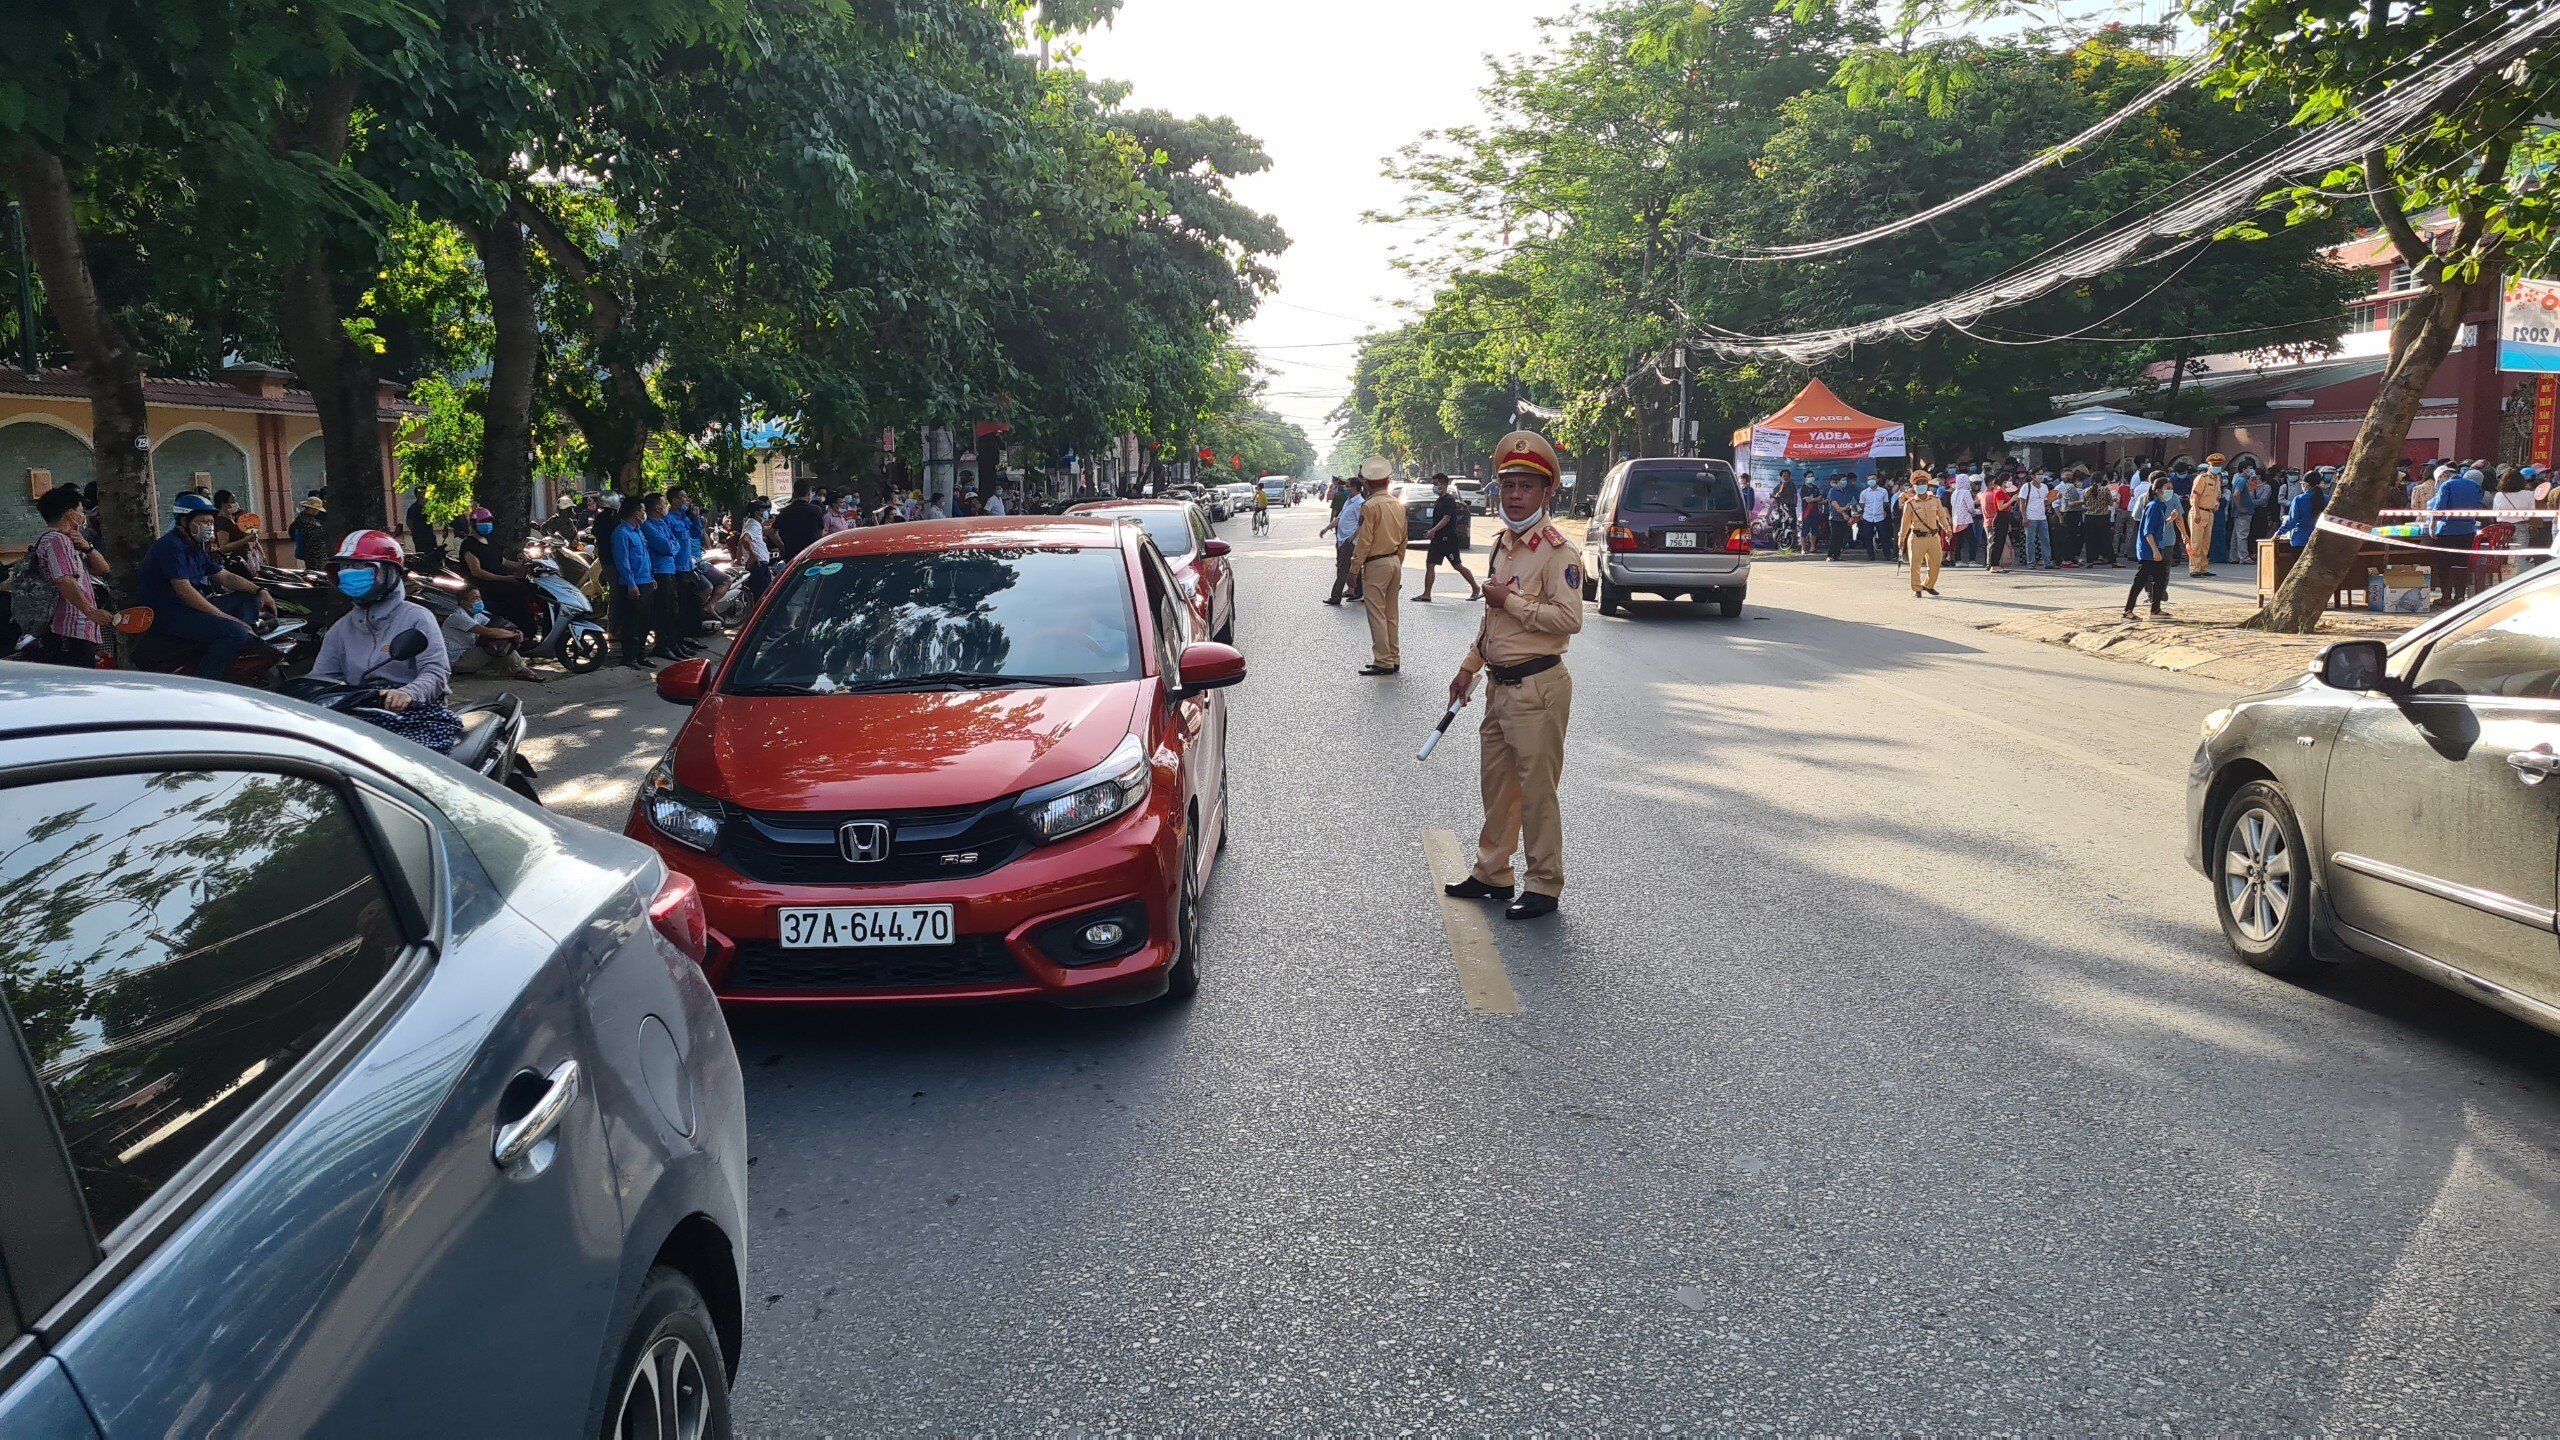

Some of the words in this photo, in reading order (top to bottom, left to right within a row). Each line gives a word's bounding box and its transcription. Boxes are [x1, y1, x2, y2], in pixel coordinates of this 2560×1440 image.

[1808, 431, 1851, 441] YADEA
[940, 853, 979, 865] RS
[783, 910, 949, 944] 37A-644.70
